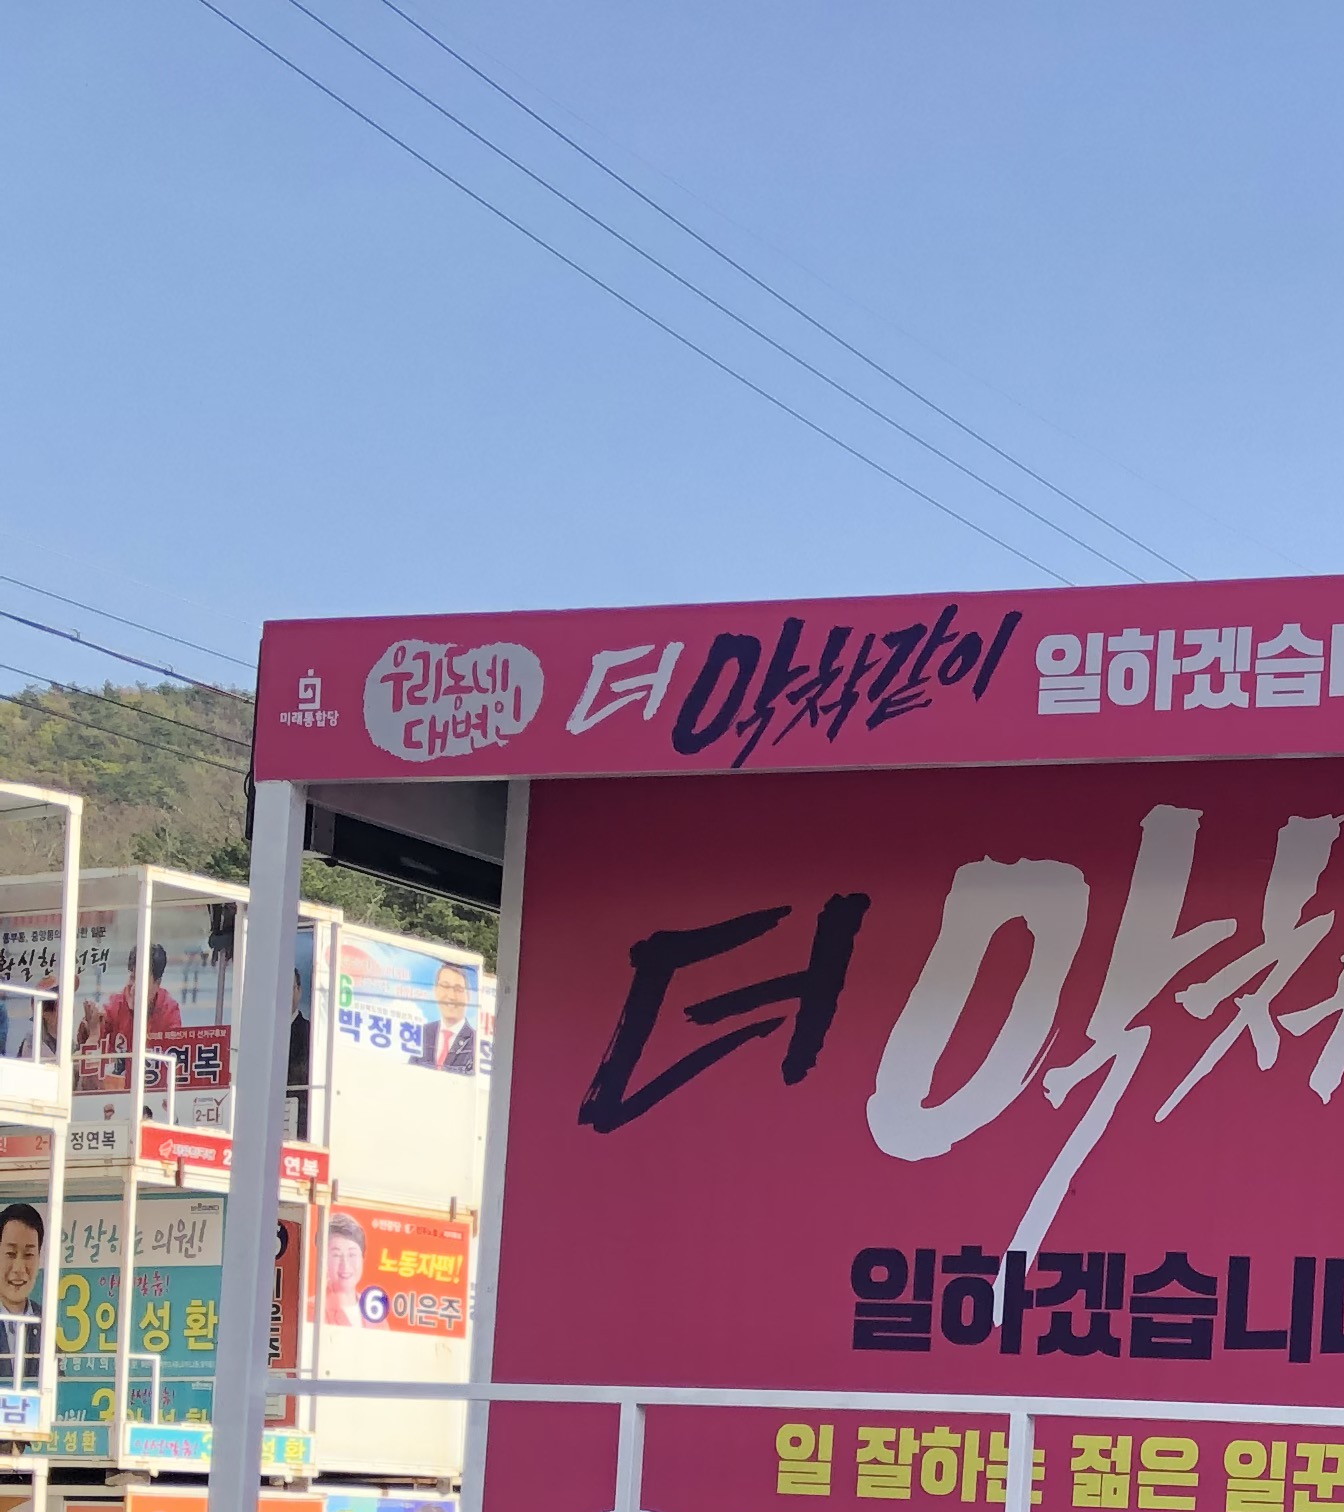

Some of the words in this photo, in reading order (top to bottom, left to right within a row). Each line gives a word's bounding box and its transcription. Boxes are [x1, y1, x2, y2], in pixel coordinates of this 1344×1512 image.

[380, 644, 512, 715] 우리동네
[565, 641, 686, 736] 더
[279, 708, 339, 729] 미래통합당
[402, 684, 521, 756] 대변인
[338, 1007, 424, 1057] 박정현
[576, 891, 872, 1135] 더
[70, 1129, 116, 1151] 정연복
[377, 1247, 465, 1285] 노동자편!
[56, 1274, 92, 1353] 3
[365, 1290, 385, 1320] 6
[393, 1291, 464, 1331] 이은주
[773, 1421, 835, 1498] 일
[853, 1424, 1046, 1507] 잘하는
[1070, 1431, 1200, 1511] 젊은
